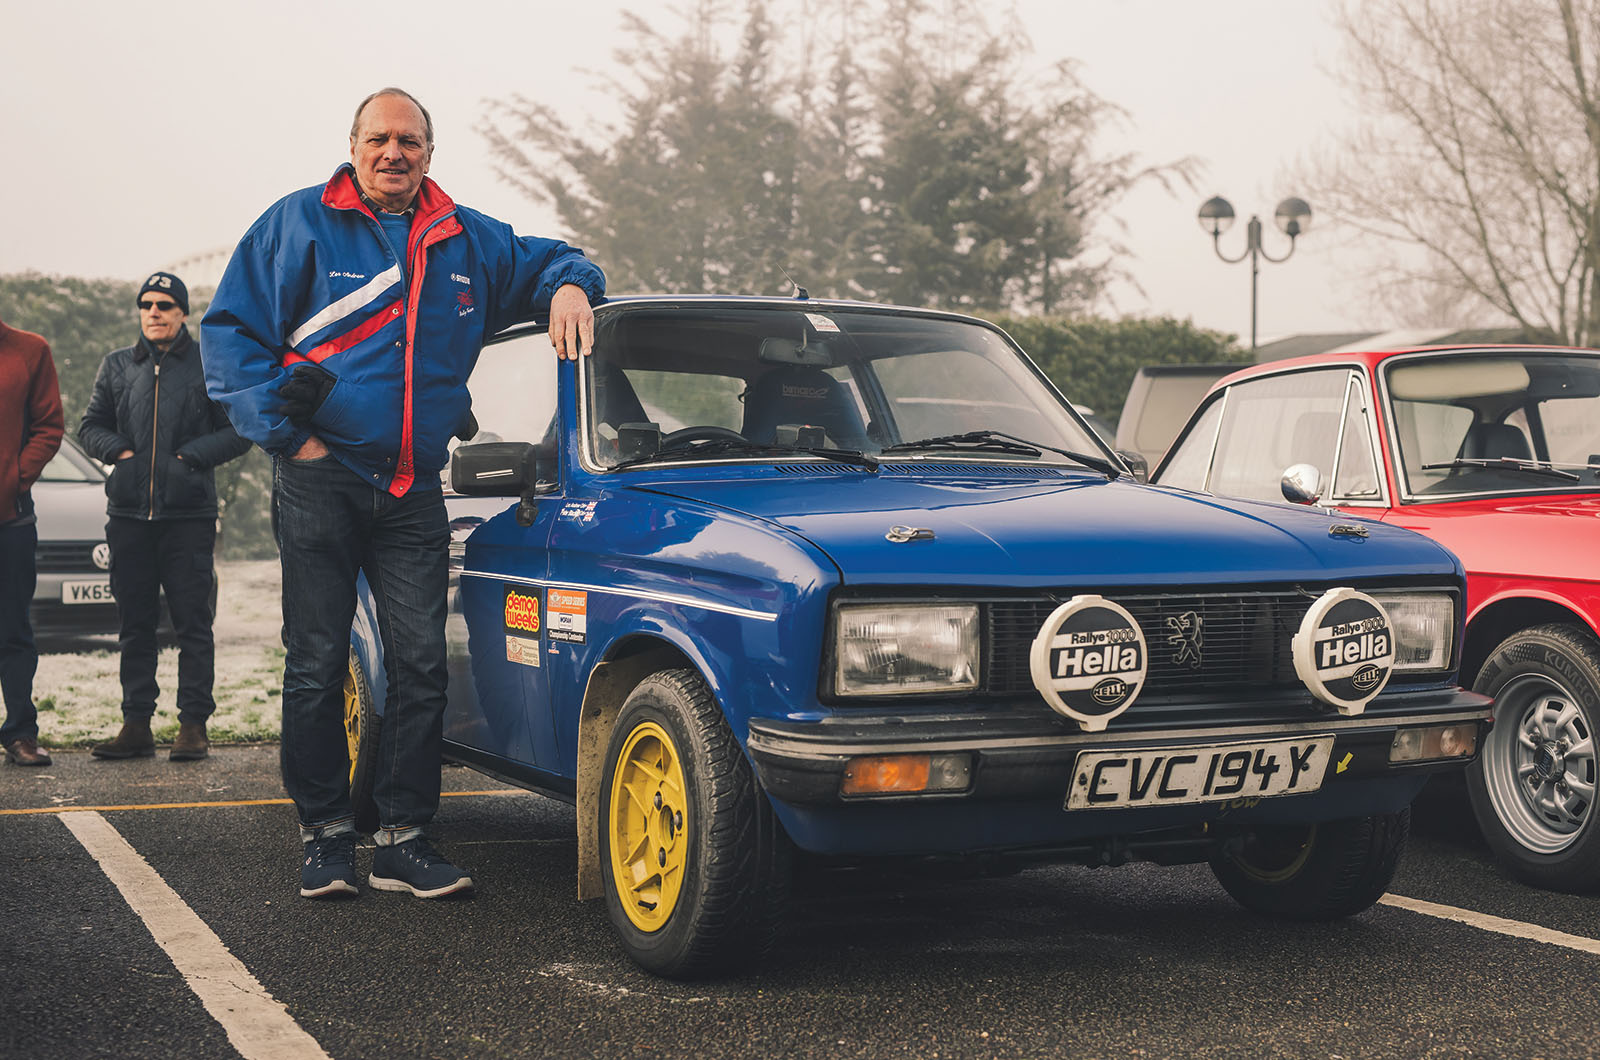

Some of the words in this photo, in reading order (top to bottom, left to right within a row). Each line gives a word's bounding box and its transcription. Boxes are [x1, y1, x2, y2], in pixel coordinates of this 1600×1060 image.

[506, 591, 539, 613] demon
[505, 607, 540, 632] tweeks
[1331, 623, 1360, 637] Rallye
[1361, 617, 1386, 632] 1000
[1071, 632, 1105, 645] Rallye
[1106, 629, 1136, 643] 1000
[1057, 645, 1137, 676] Hella
[1322, 633, 1387, 667] Hella
[1353, 669, 1380, 682] HELLA
[1544, 650, 1594, 706] KUMHO
[1094, 683, 1127, 696] HELLA
[1087, 754, 1198, 803] CVC
[1201, 743, 1317, 796] 194Y
